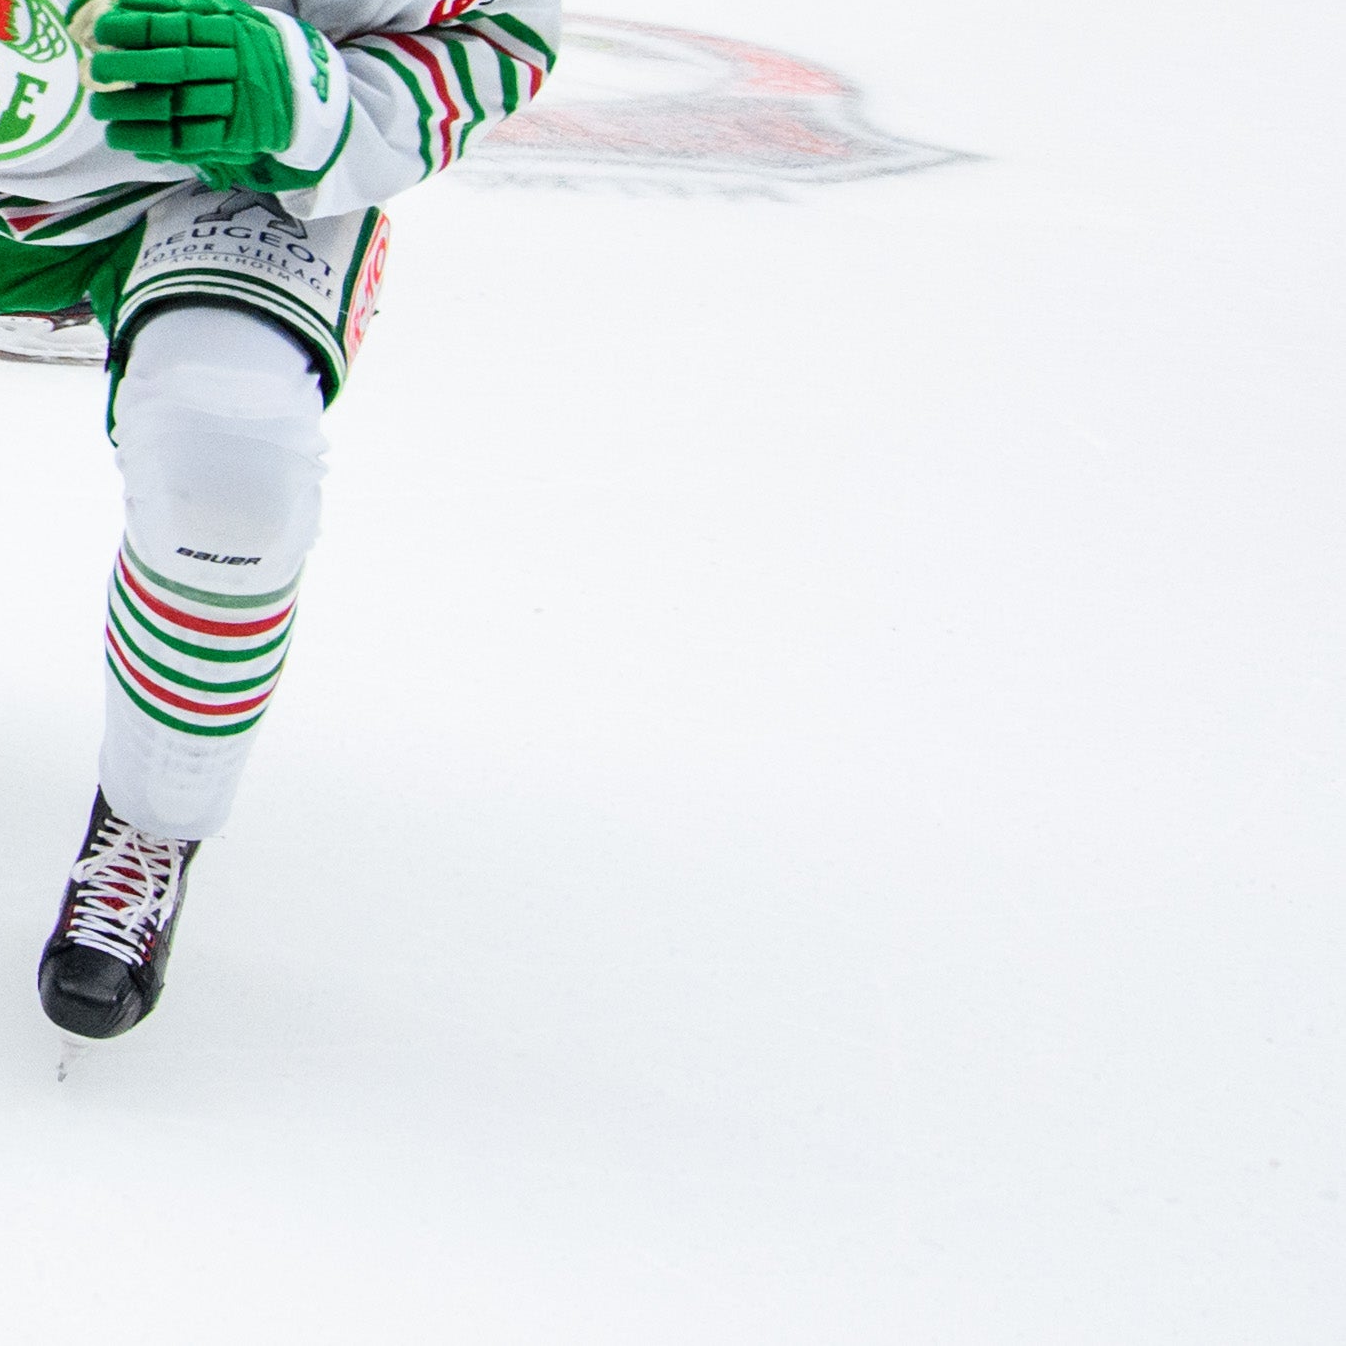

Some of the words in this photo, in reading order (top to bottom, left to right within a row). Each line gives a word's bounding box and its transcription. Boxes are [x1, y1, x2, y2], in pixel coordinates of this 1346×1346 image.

[143, 226, 336, 277] PEUGEOT
[238, 245, 333, 298] VILLAGE
[175, 547, 262, 565] BAUER
